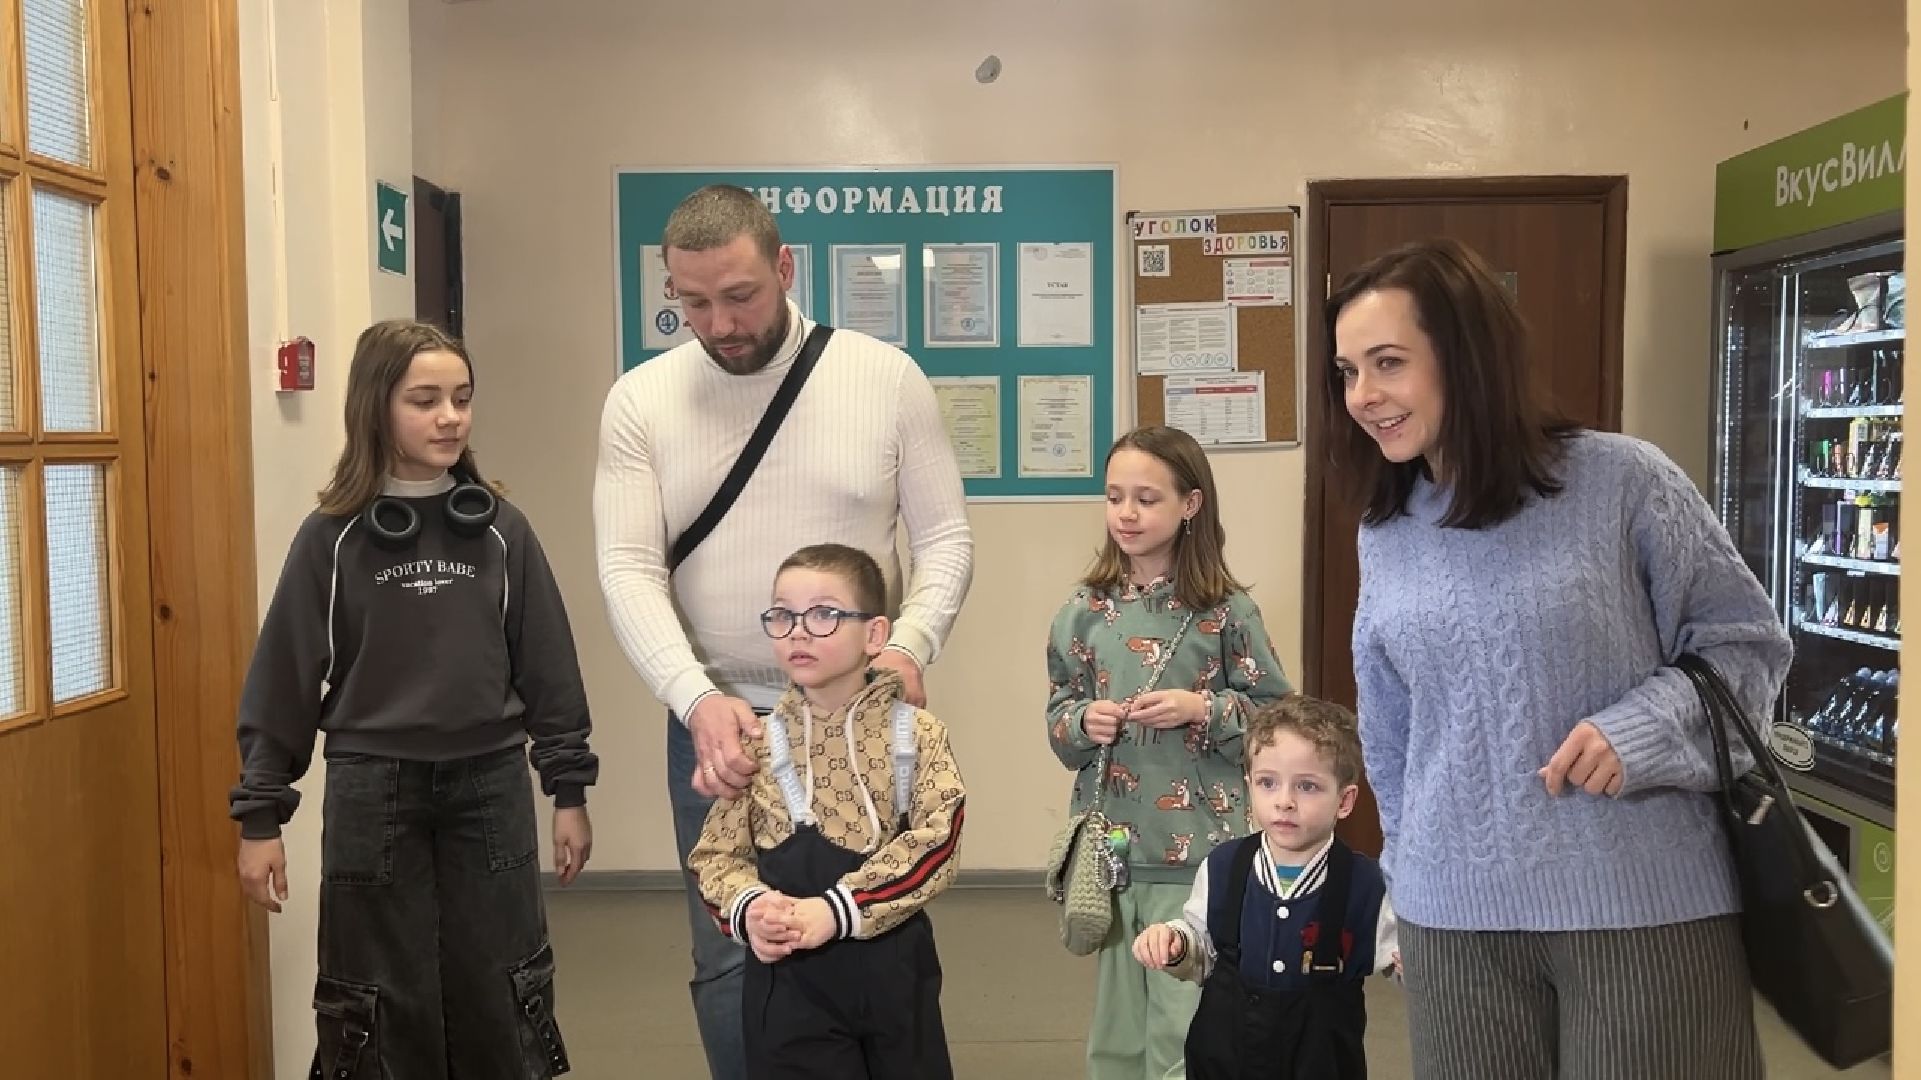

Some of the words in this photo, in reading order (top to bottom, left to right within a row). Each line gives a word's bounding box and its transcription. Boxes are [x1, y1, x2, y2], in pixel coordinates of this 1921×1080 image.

[744, 184, 1004, 216] НФОРМАЦИЯ
[1135, 218, 1216, 237] УГОЛОК
[1204, 235, 1289, 254] ЗДОРОВЬЯ
[374, 559, 433, 585] SPORTY
[437, 560, 476, 578] BABE
